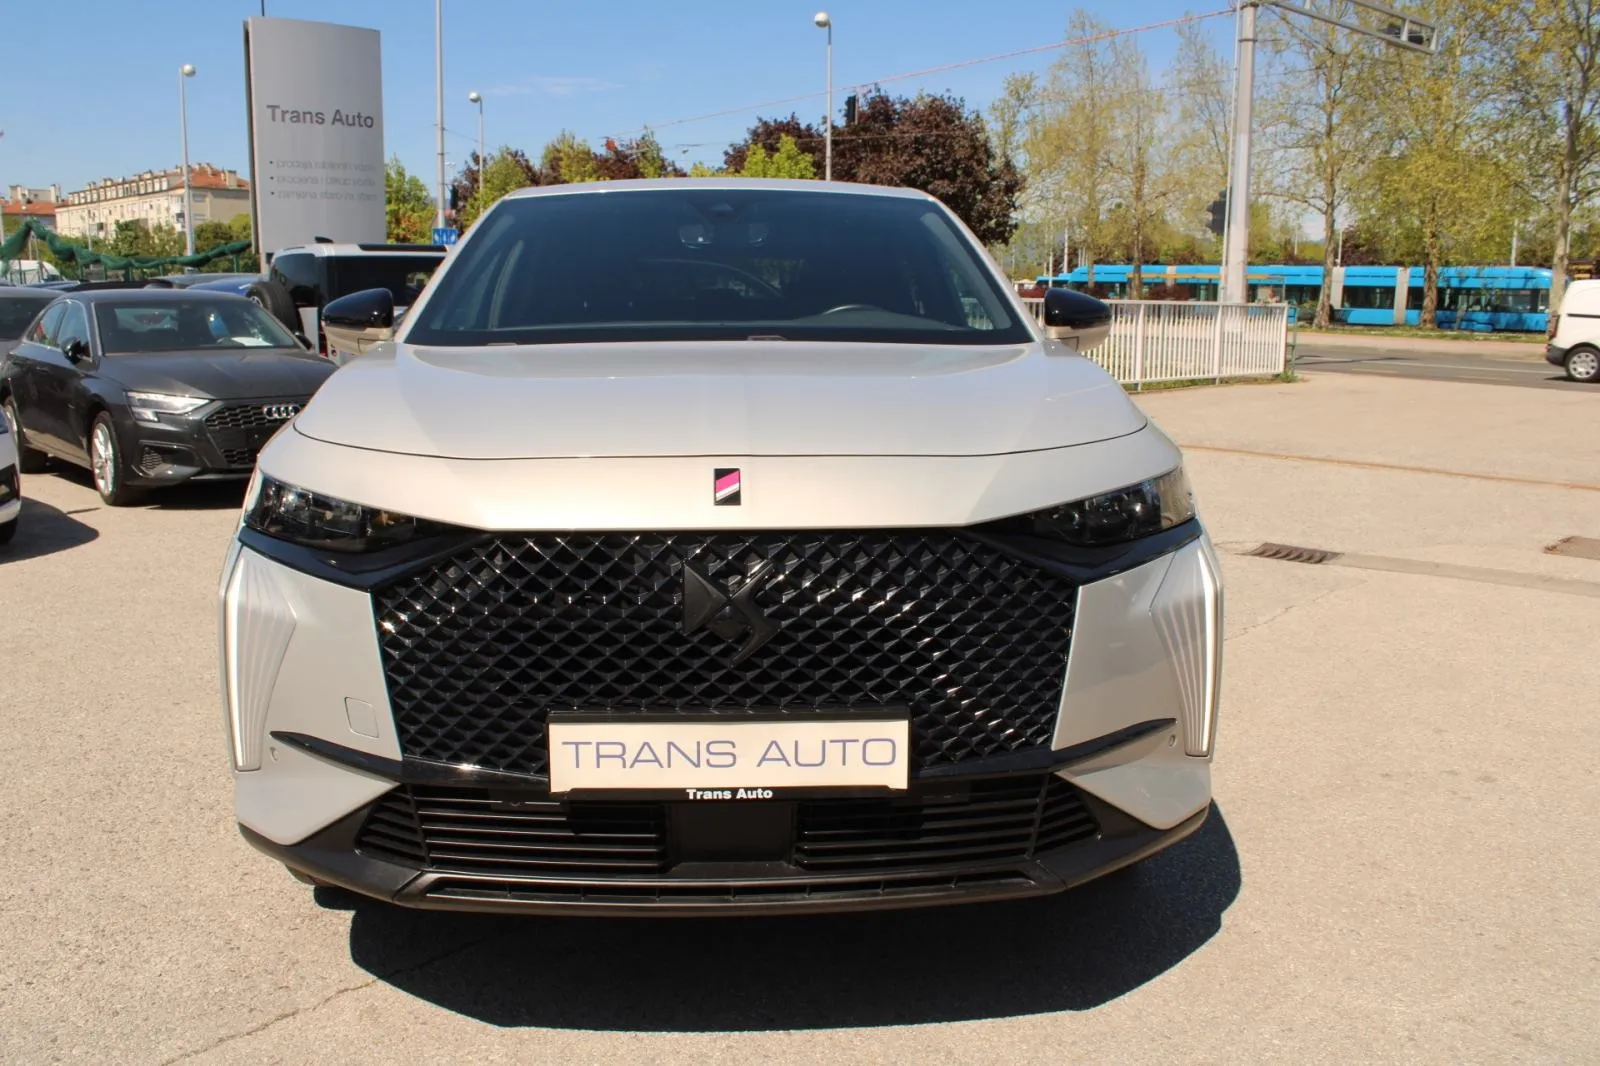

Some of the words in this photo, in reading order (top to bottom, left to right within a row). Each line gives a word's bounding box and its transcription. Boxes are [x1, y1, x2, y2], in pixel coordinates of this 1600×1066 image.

[267, 105, 326, 125] Trans
[331, 109, 374, 128] Auto
[562, 740, 737, 769] TRANS
[756, 738, 897, 768] AUTO
[686, 788, 732, 800] Trans
[736, 788, 773, 799] Auto
